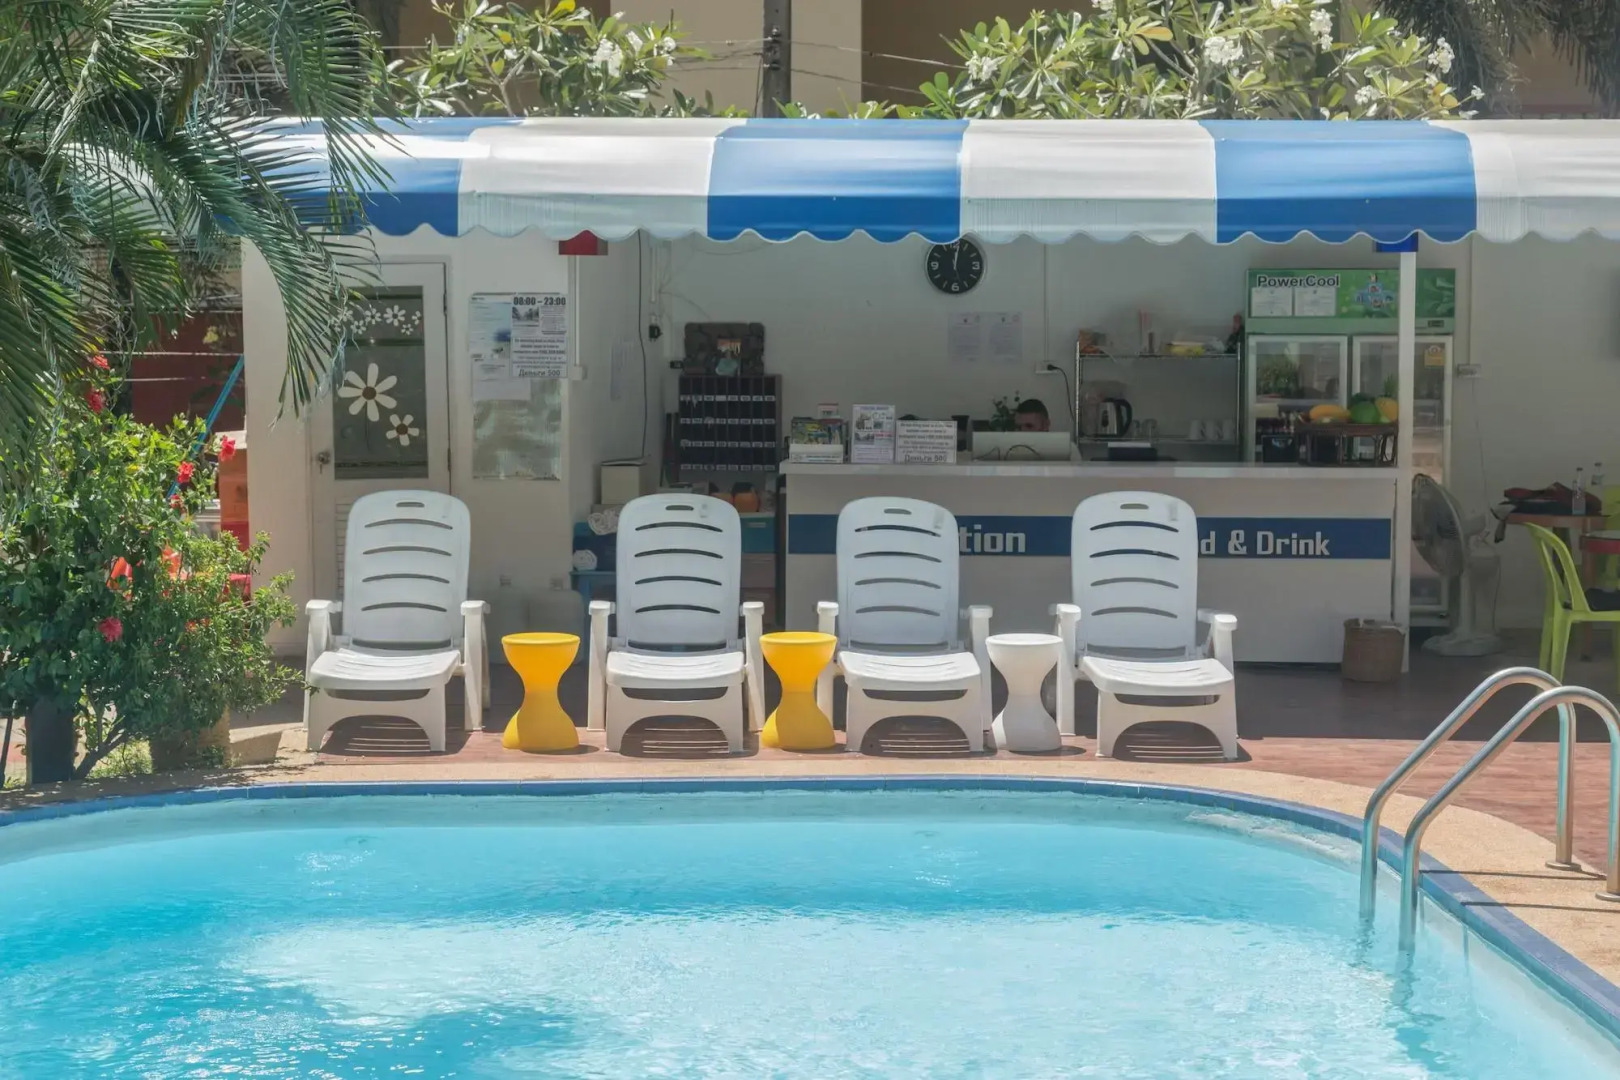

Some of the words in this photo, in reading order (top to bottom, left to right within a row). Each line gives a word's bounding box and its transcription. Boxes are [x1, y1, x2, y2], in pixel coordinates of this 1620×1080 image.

[930, 261, 939, 270] 9
[972, 261, 980, 270] 3
[1257, 274, 1340, 288] PowerCool
[951, 283, 960, 292] 6
[513, 296, 536, 306] 08:00
[543, 296, 566, 306] 23:00
[958, 523, 1026, 553] tion
[1227, 529, 1248, 555] &
[1256, 530, 1331, 556] Drink
